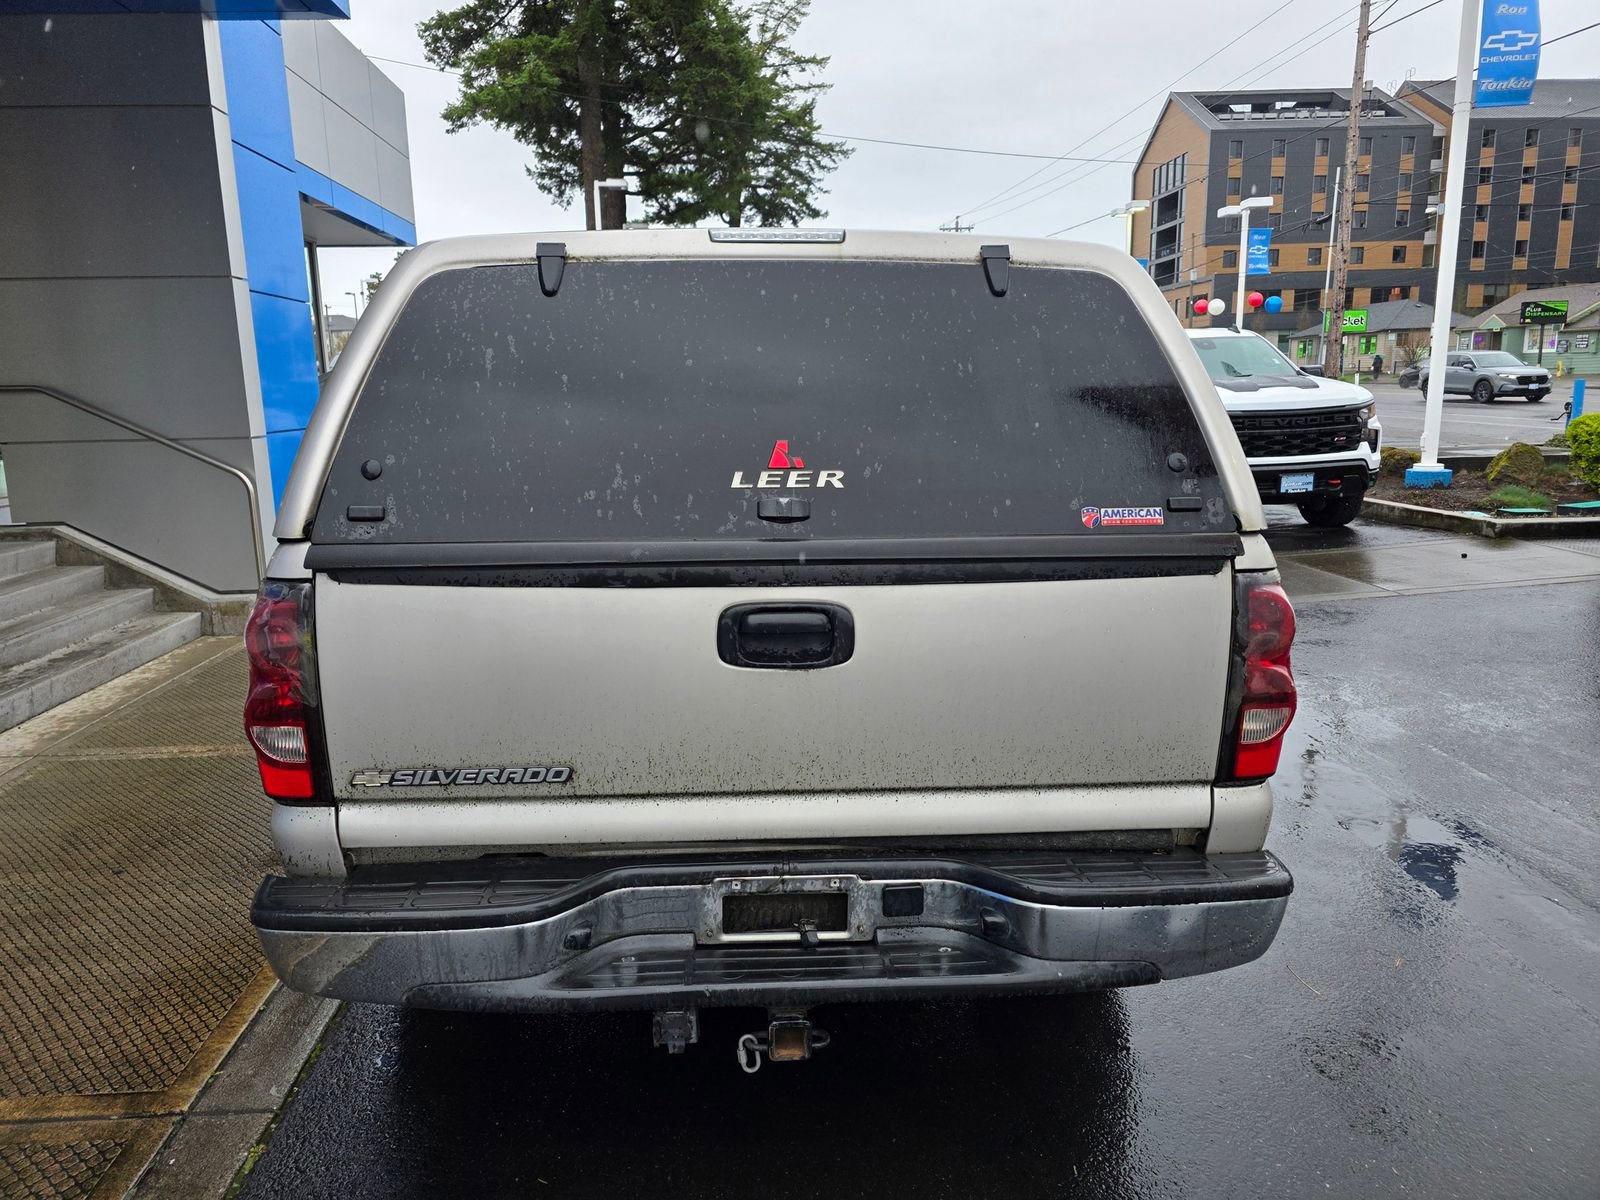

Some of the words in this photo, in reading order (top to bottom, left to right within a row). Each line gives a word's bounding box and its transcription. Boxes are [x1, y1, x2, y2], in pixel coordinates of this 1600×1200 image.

[1496, 4, 1527, 14] Ron
[1481, 53, 1537, 63] CHEVROLET
[1481, 77, 1533, 90] Tonkin
[1328, 316, 1365, 326] cket
[730, 470, 845, 488] LEER
[392, 767, 572, 786] SILVERADO
